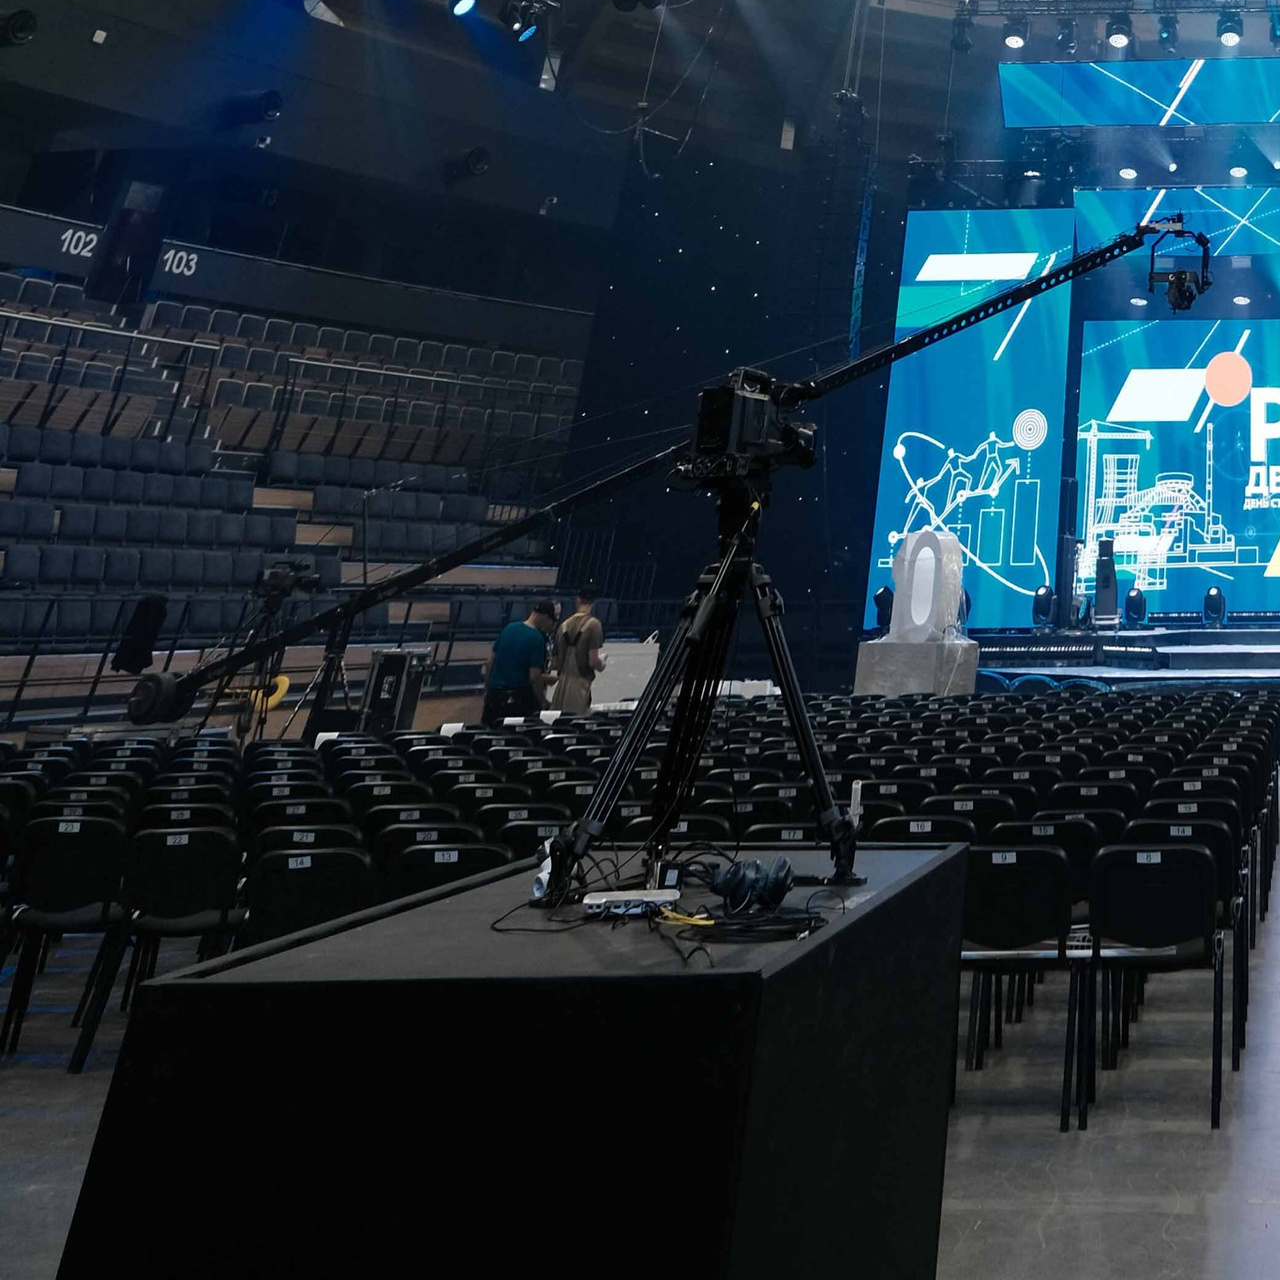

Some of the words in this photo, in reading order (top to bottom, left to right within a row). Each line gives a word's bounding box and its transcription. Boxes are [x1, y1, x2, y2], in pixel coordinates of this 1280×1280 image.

[61, 229, 98, 257] 102
[164, 250, 198, 276] 103
[1243, 497, 1269, 510] ДЕНЬ
[916, 822, 925, 831] 16
[788, 831, 797, 839] 17
[442, 852, 452, 861] 13
